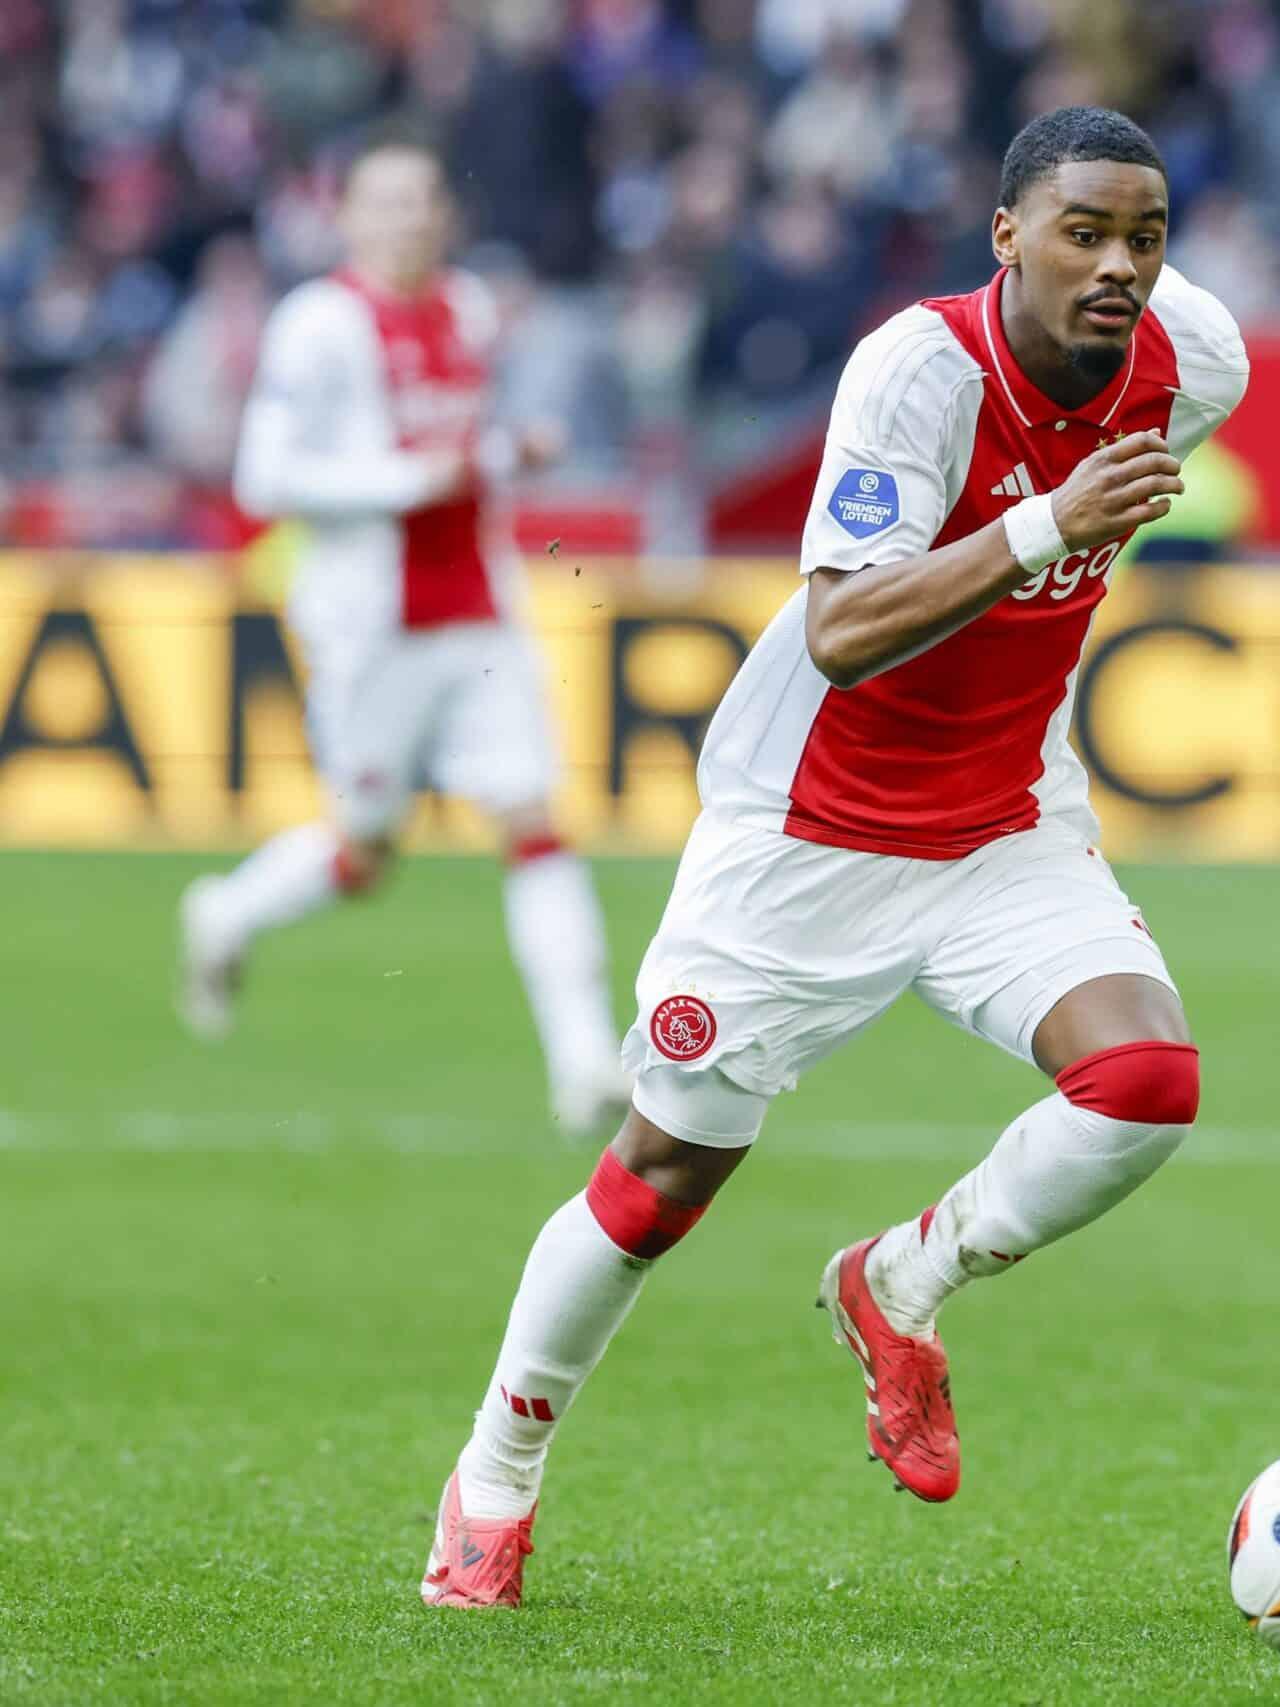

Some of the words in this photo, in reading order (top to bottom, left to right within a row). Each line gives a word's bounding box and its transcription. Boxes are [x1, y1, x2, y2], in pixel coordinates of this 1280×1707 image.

[838, 500, 892, 517] VRIENDEN
[1011, 542, 1120, 601] ggo
[656, 999, 686, 1021] AJAX
